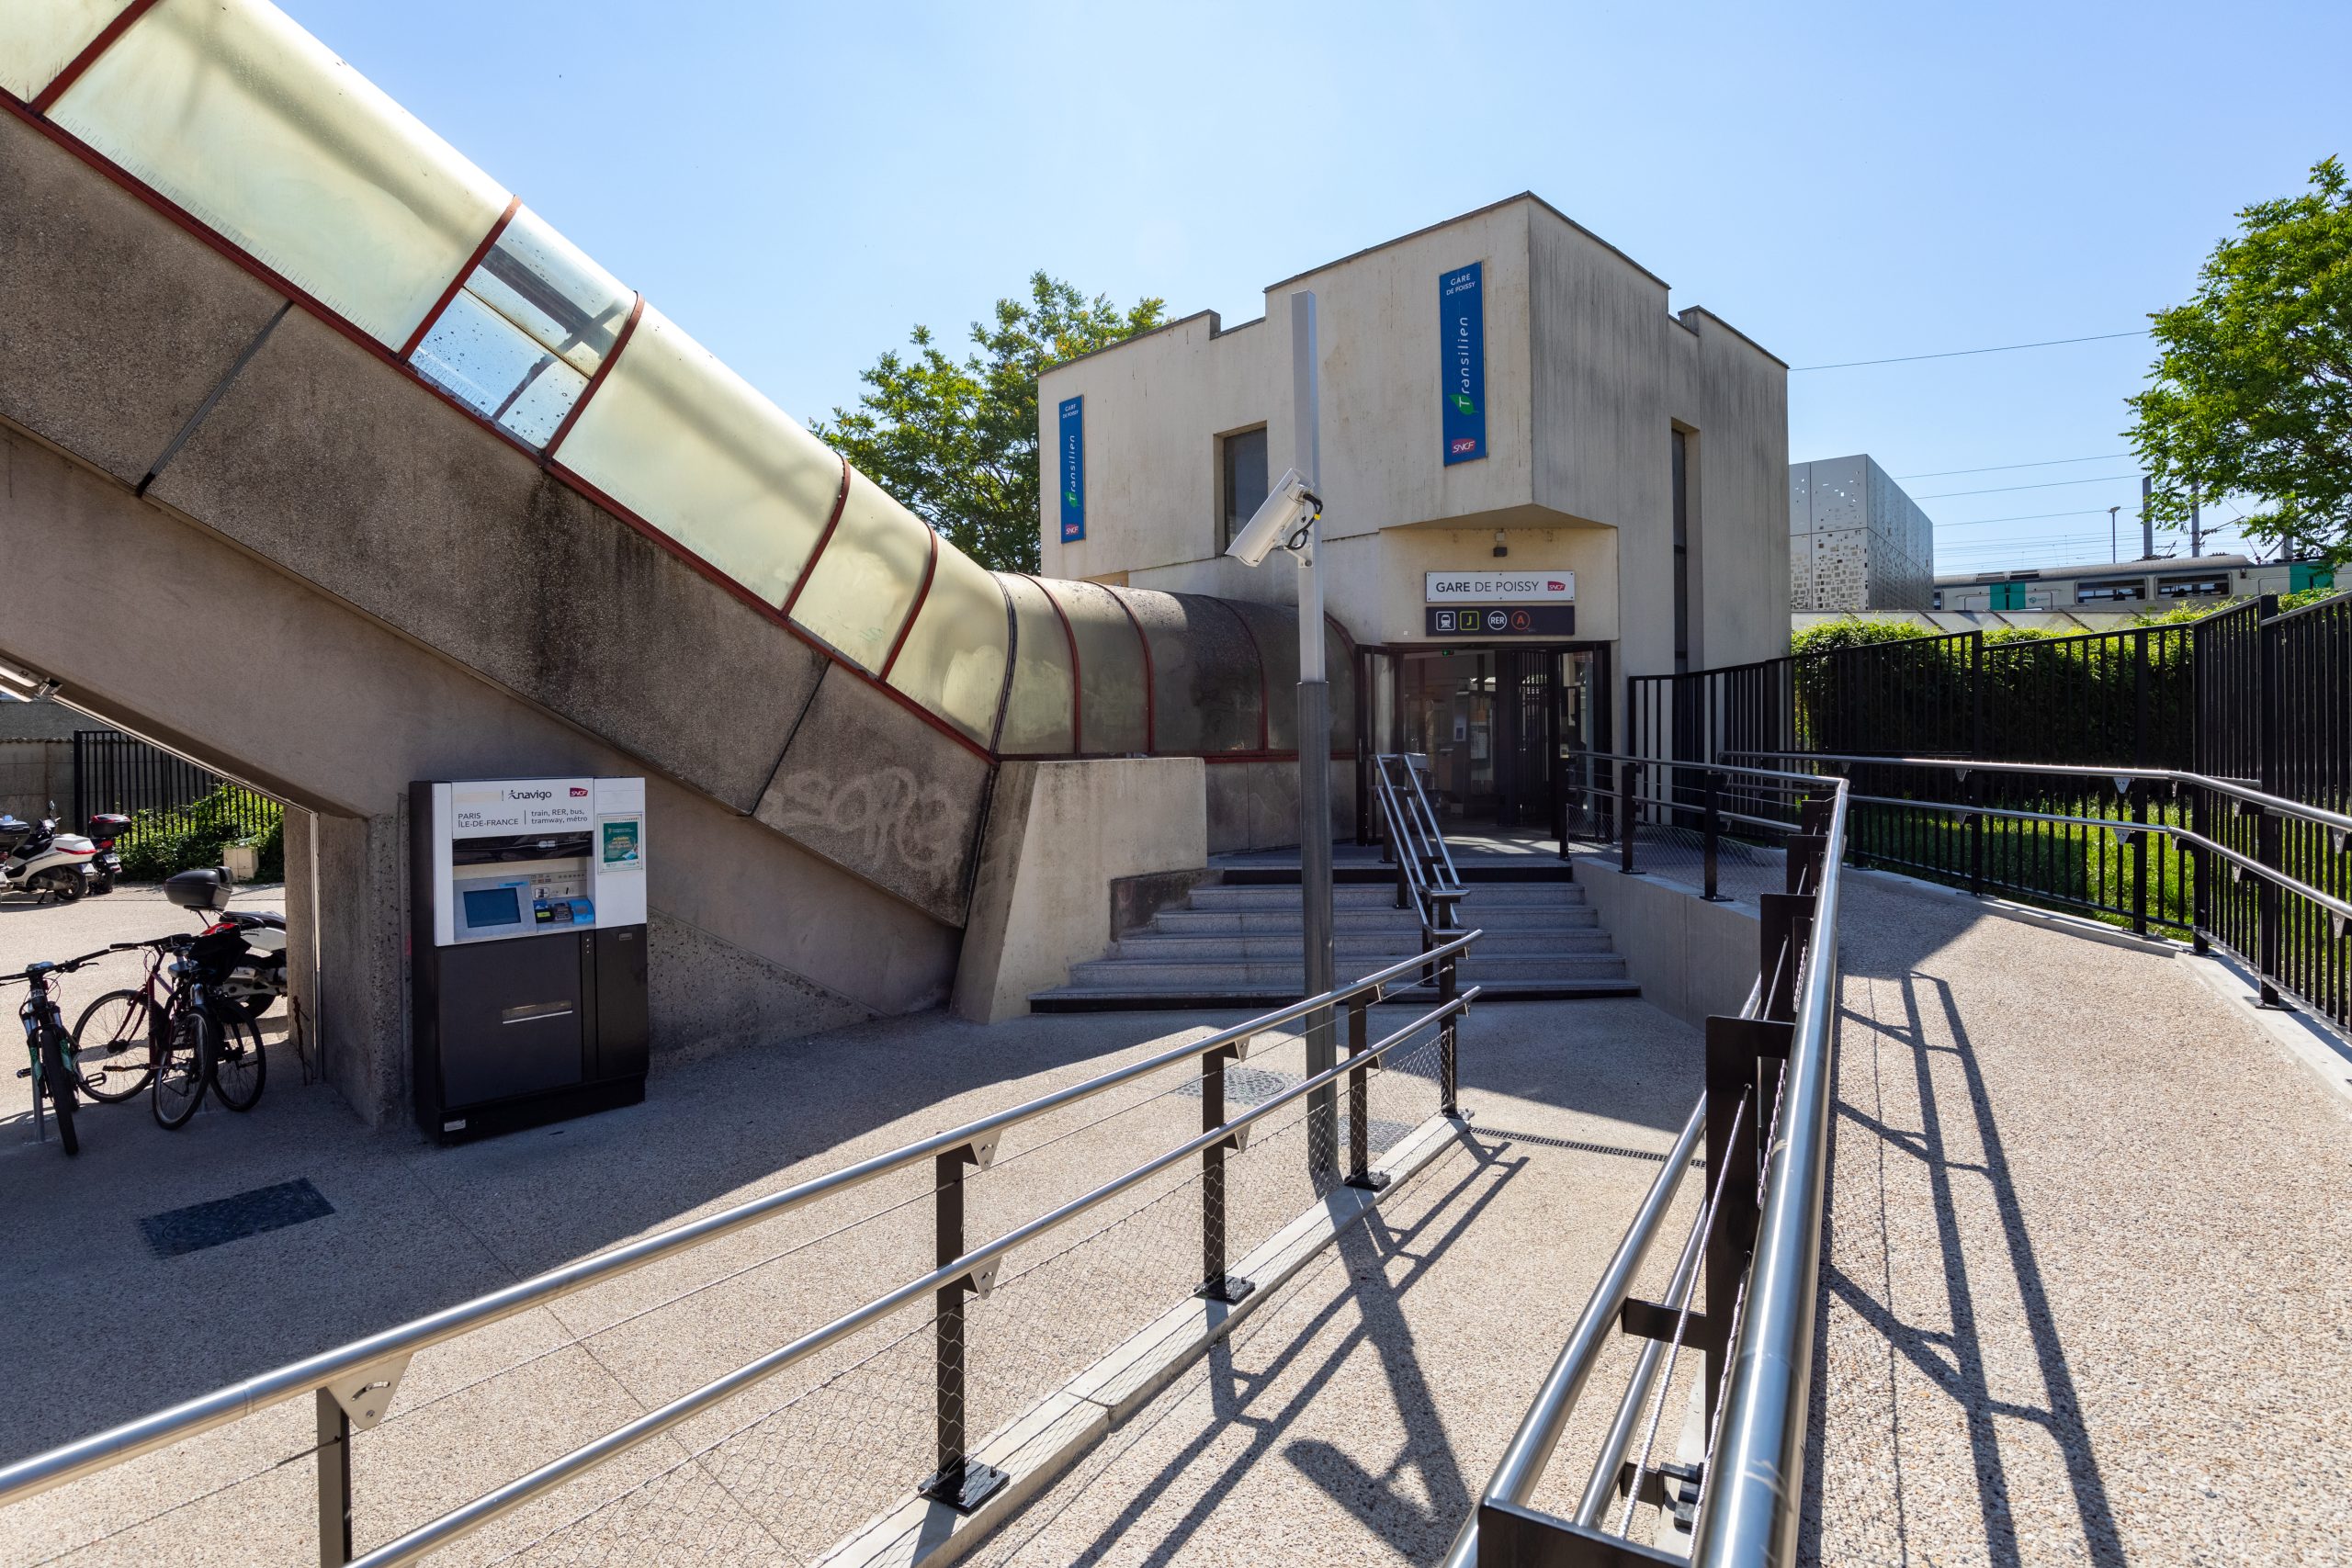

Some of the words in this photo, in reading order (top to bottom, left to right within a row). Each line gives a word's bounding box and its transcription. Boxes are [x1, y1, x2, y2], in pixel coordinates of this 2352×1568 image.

[1451, 274, 1471, 286] GARE
[1446, 288, 1453, 296] DE
[1455, 281, 1476, 292] POISSY
[1457, 317, 1470, 407] Transilien
[1453, 441, 1475, 453] SNCF
[1066, 525, 1079, 535] SNCF
[1436, 581, 1470, 592] GARE
[1475, 581, 1492, 592] DE
[1496, 581, 1539, 592] POISSY
[1548, 582, 1566, 591] SNCF
[1466, 615, 1473, 626] J
[1490, 616, 1505, 625] RER
[1517, 615, 1525, 626] A
[516, 789, 552, 801] navigo
[458, 812, 481, 820] PARIS
[551, 808, 569, 817] RER,
[570, 807, 585, 816] bus,
[458, 818, 519, 828] ÎLE-DE-FRANCE
